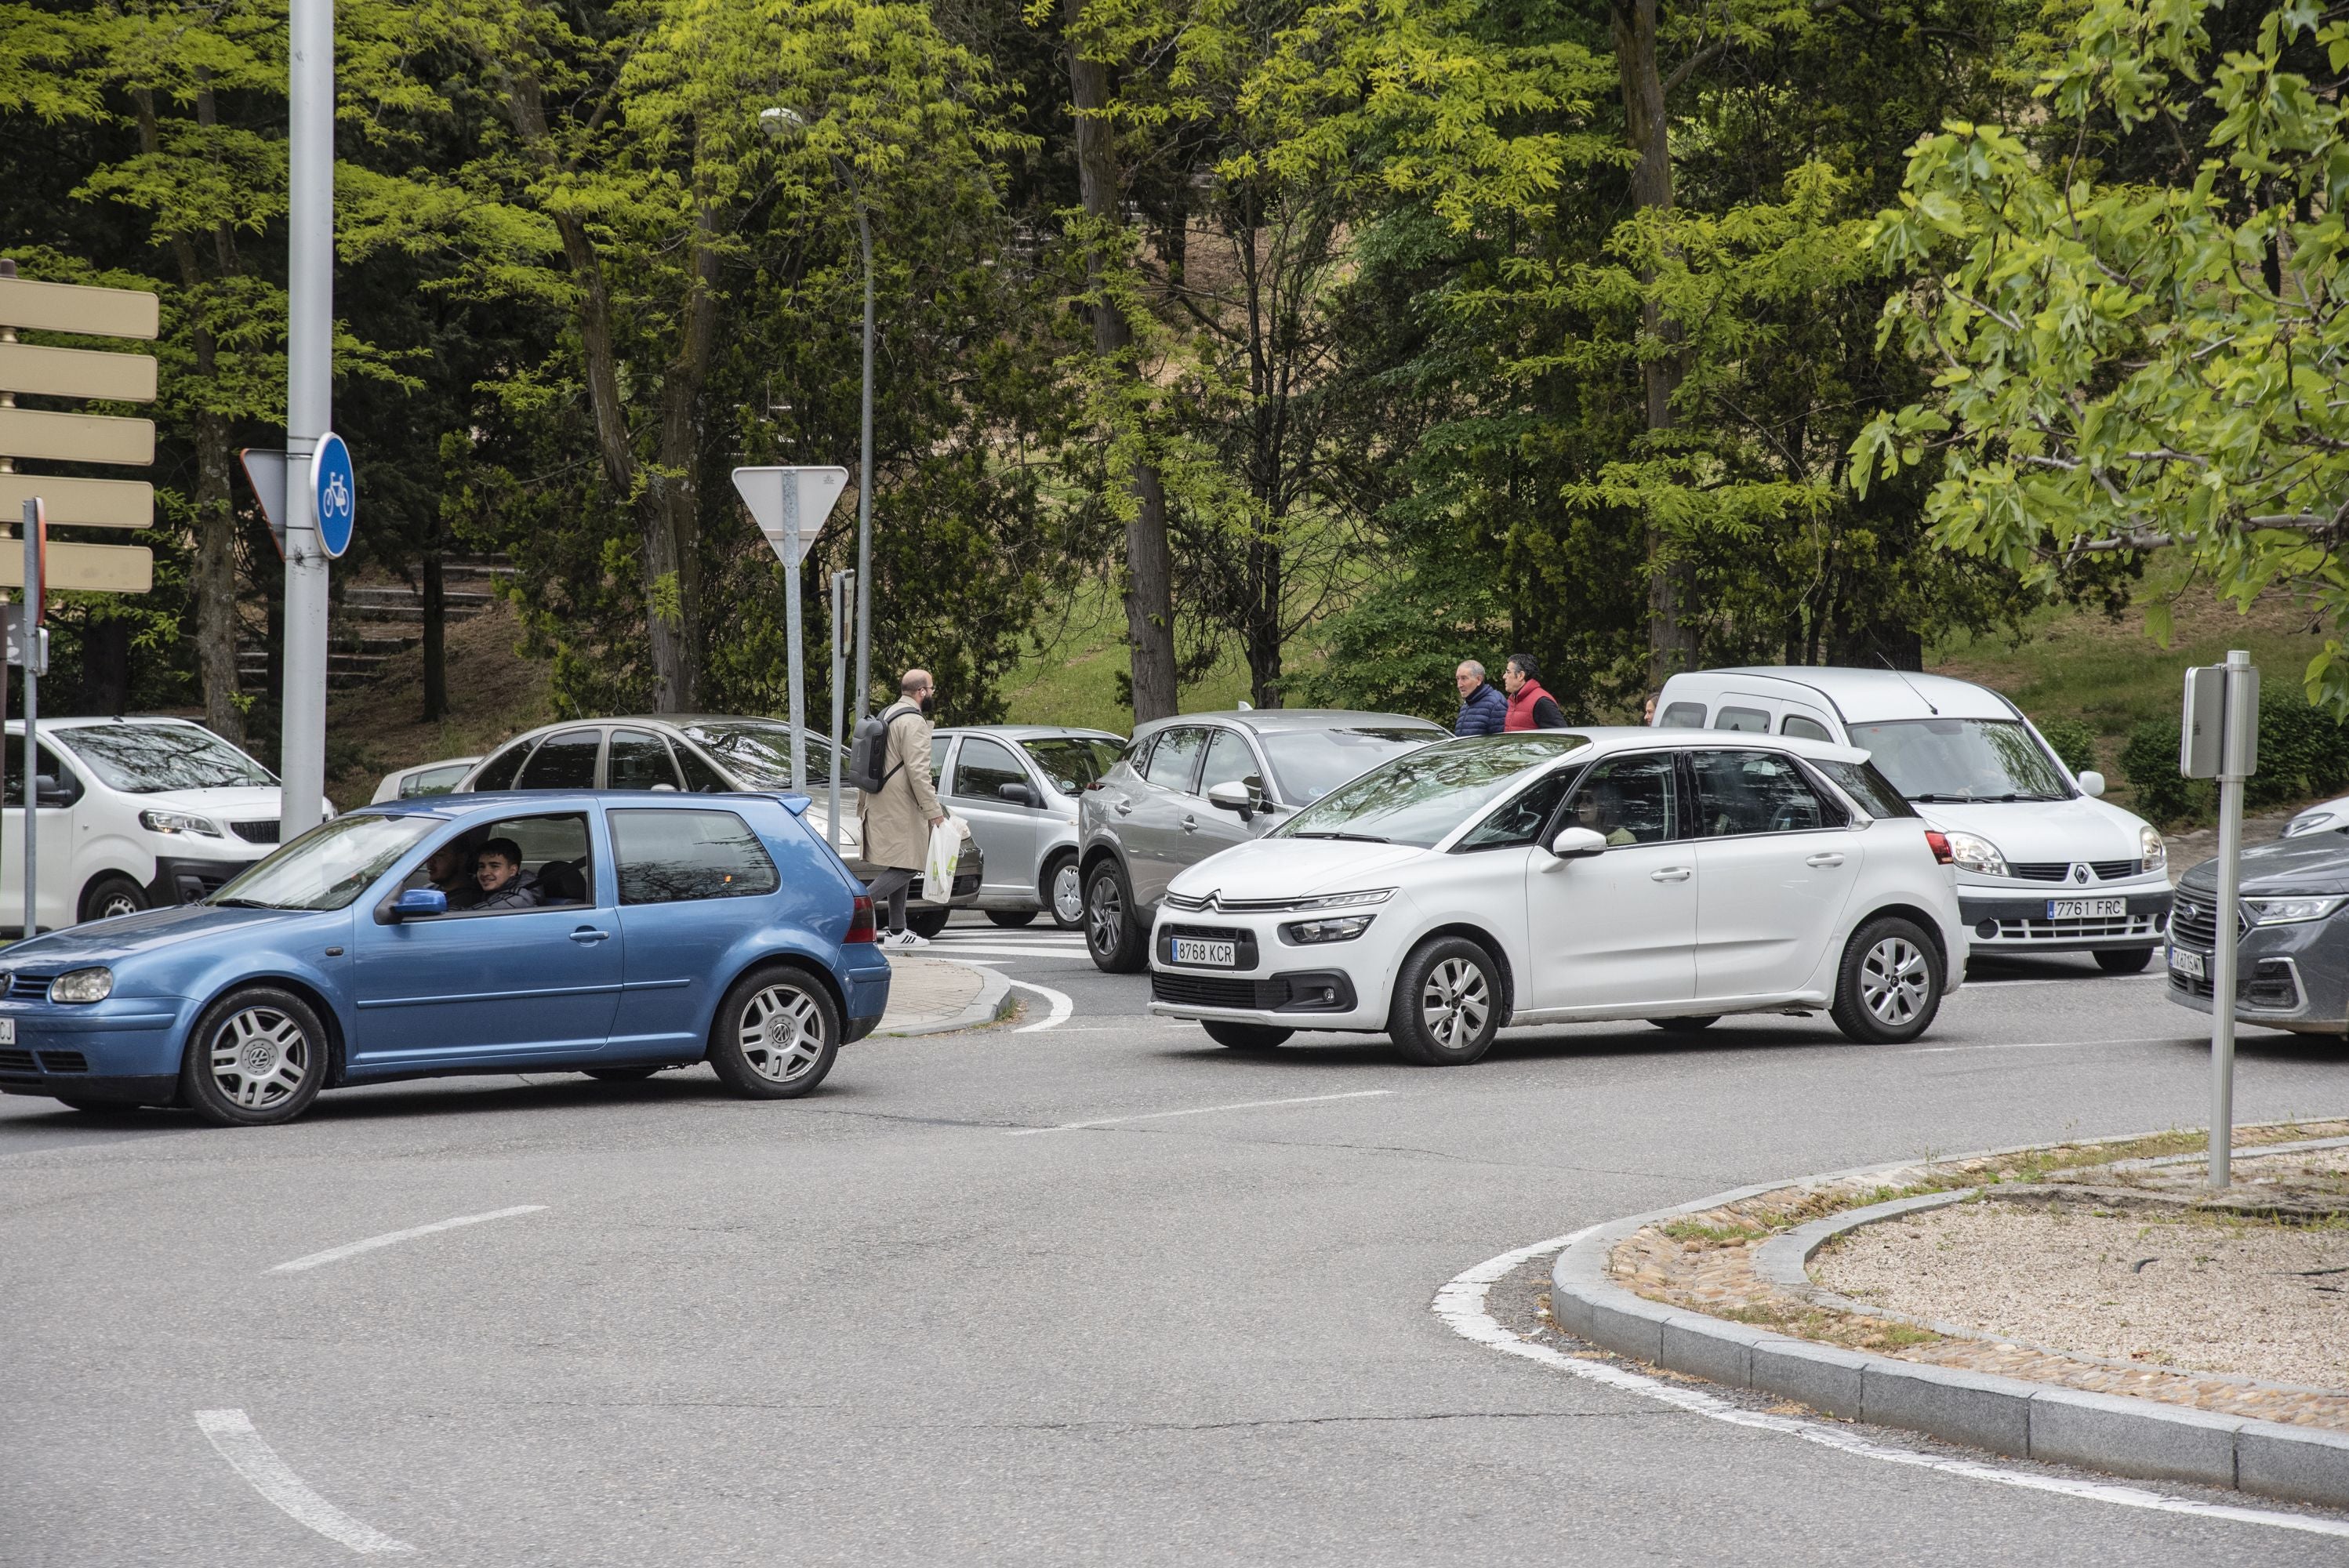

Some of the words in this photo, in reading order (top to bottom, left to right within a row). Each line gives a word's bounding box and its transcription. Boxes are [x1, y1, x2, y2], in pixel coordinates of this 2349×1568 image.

[2057, 902, 2089, 916] 7761
[2097, 900, 2121, 914] FRC
[1179, 943, 1206, 960] 8768
[1210, 945, 1232, 962] KCR
